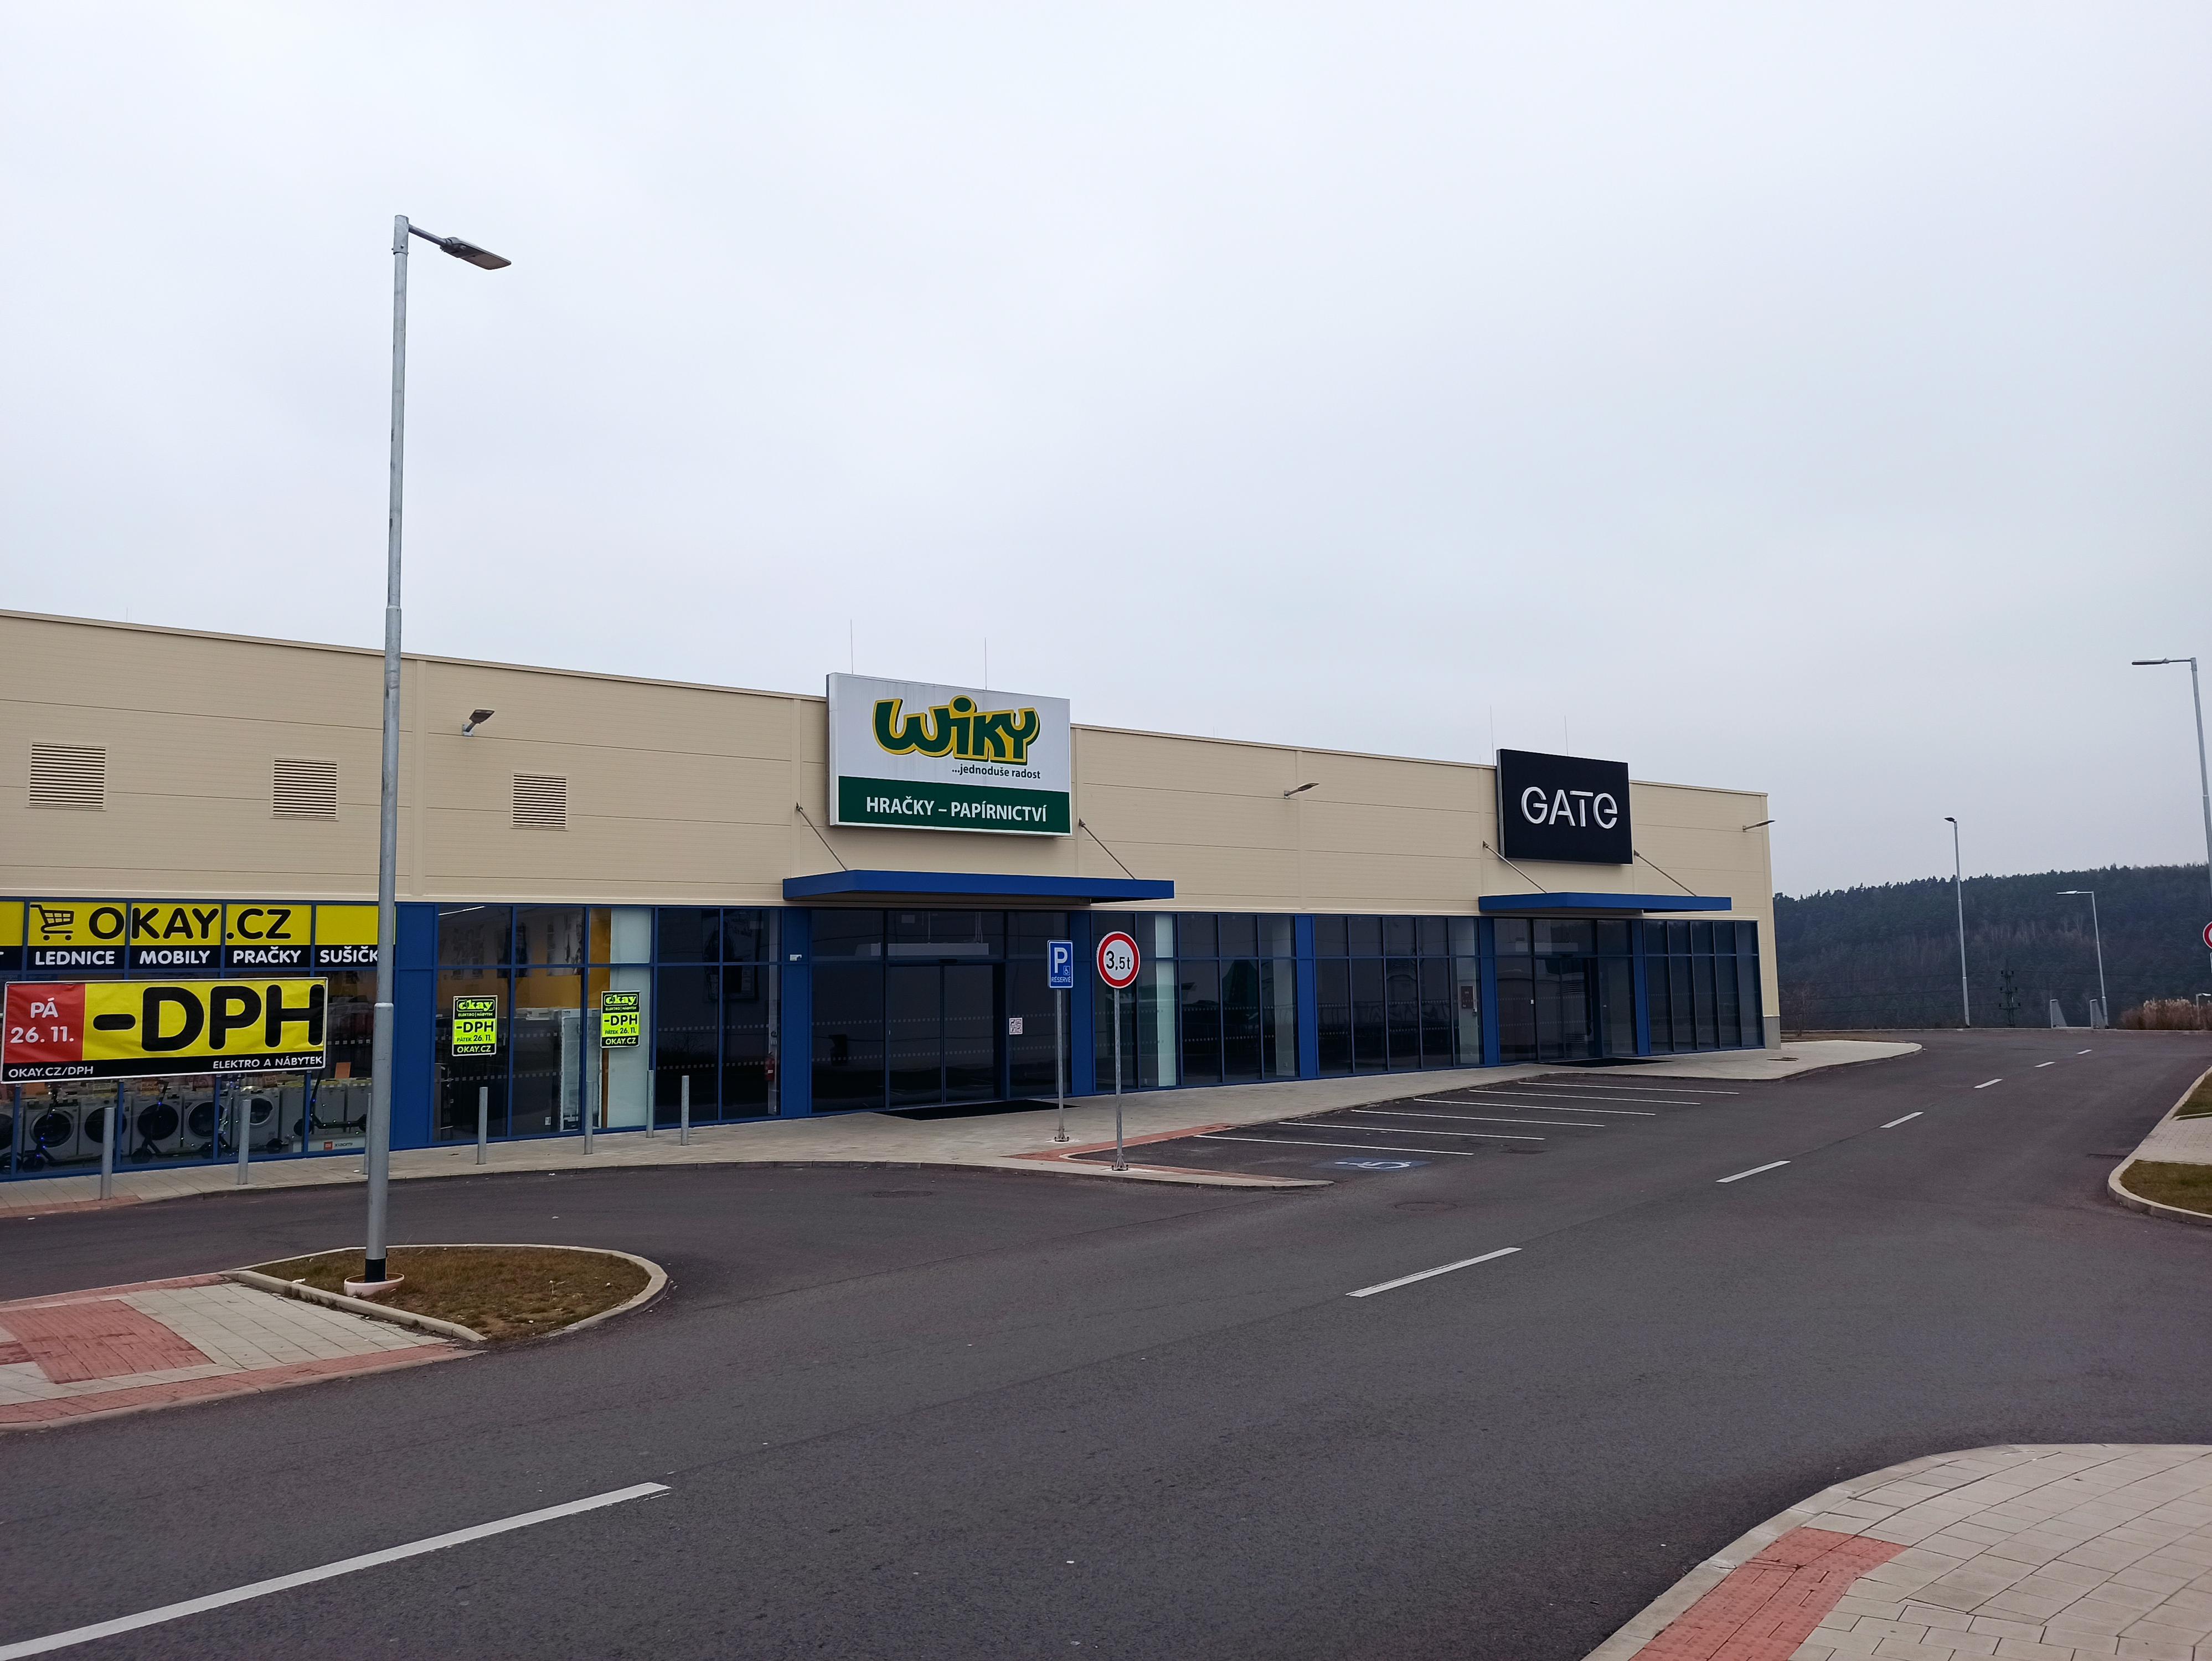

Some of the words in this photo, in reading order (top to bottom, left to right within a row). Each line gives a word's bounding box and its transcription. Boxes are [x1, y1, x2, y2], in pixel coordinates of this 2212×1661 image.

[952, 764, 1009, 777] ...jednoduše
[1011, 768, 1040, 778] radost
[866, 796, 935, 816] HRAČKY
[951, 801, 1047, 822] PAPÍRNICTVÍ
[89, 906, 291, 940] OKAY.CZ
[35, 951, 115, 965] LEDNICE
[139, 950, 210, 964] MOBILY
[233, 946, 301, 963] PRAČKY
[319, 946, 378, 963] SUŠIČK
[30, 998, 58, 1018] PÁ
[93, 984, 324, 1051] -DPH
[604, 1014, 637, 1026] -DPH
[456, 1021, 494, 1033] -DPH
[10, 1026, 45, 1044] 26.
[50, 1026, 74, 1042] 11.
[605, 1037, 636, 1045] OKAY.CZ
[213, 1059, 260, 1069] ELEKTRO
[275, 1056, 322, 1066] NÁBYTEK
[8, 1066, 94, 1078] OKAY.CZ/DPH
